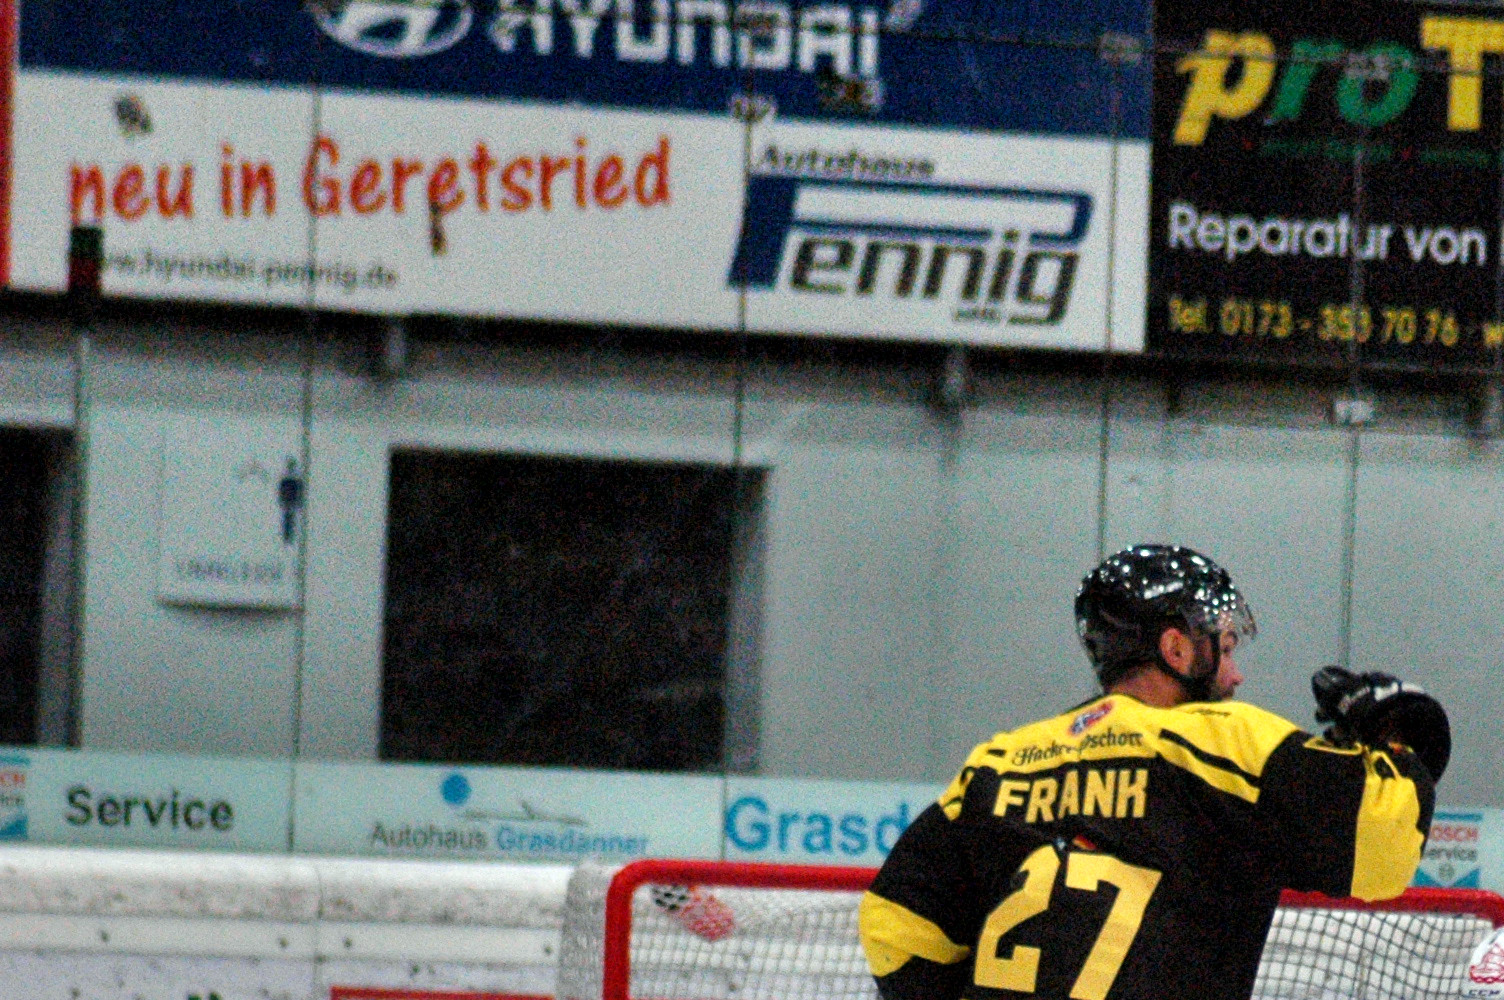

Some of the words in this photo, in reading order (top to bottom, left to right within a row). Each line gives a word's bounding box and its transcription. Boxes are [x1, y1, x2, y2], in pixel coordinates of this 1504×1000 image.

[488, 0, 880, 77] HYUNDAI
[69, 160, 196, 222] neu
[220, 140, 277, 219] in
[306, 133, 673, 217] Geretsried
[730, 173, 1094, 327] Pennig
[1168, 201, 1392, 262] Reparatur
[1405, 226, 1487, 264] von
[65, 785, 236, 832] Service
[992, 768, 1149, 825] FRANK
[370, 820, 488, 850] Autohaus
